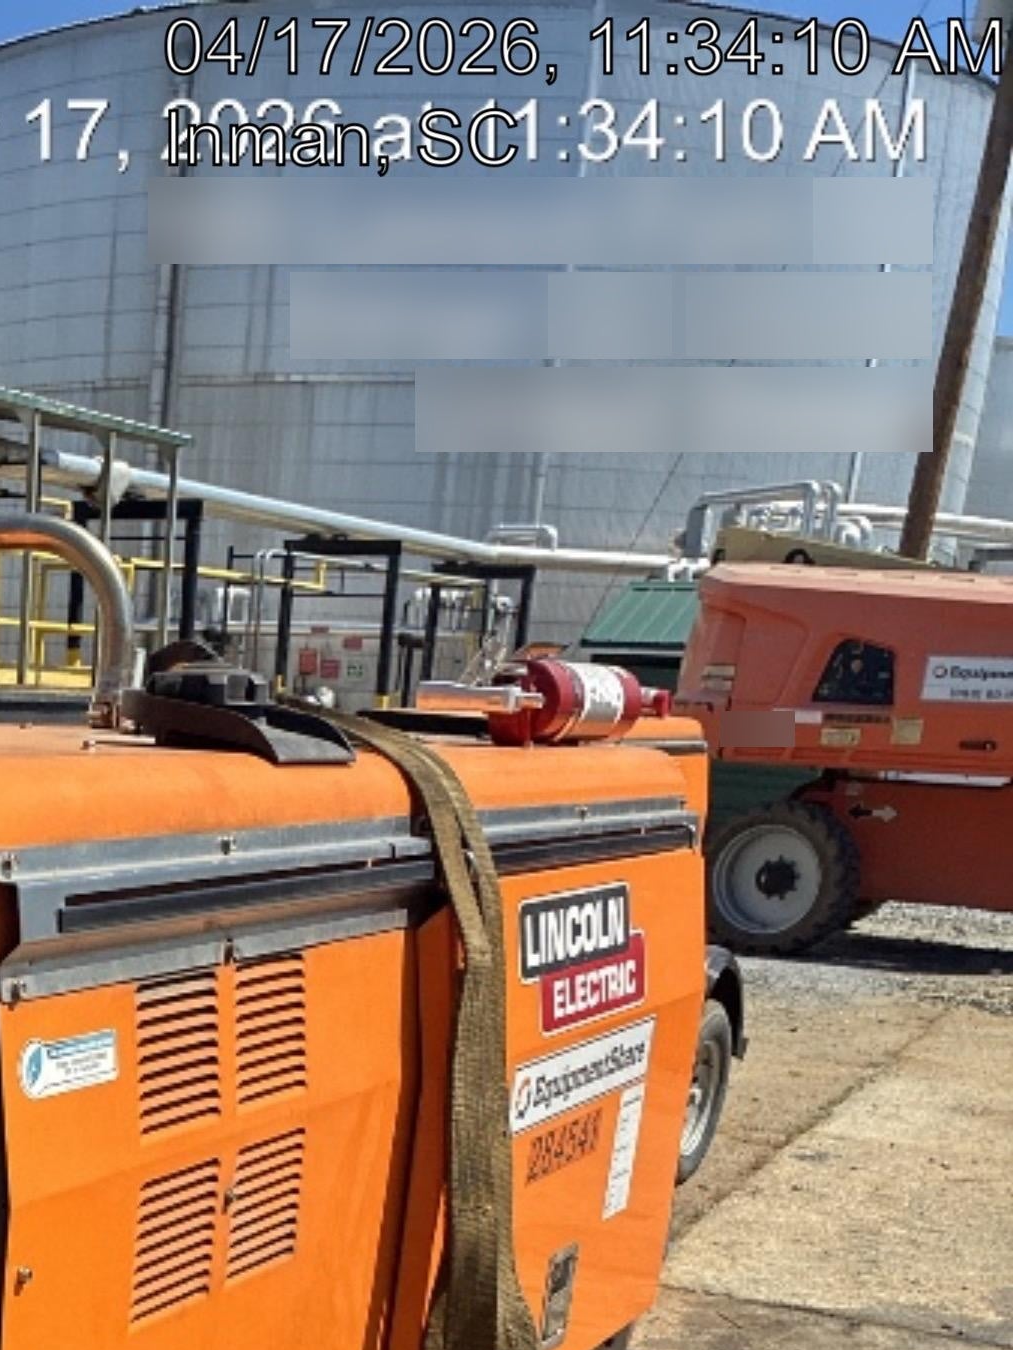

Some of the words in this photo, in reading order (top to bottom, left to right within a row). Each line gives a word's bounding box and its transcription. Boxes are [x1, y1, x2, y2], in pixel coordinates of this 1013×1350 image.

[525, 896, 625, 970] LINCOLN
[552, 959, 637, 1021] ELECTRIC
[533, 1040, 646, 1109] EquipmentShare
